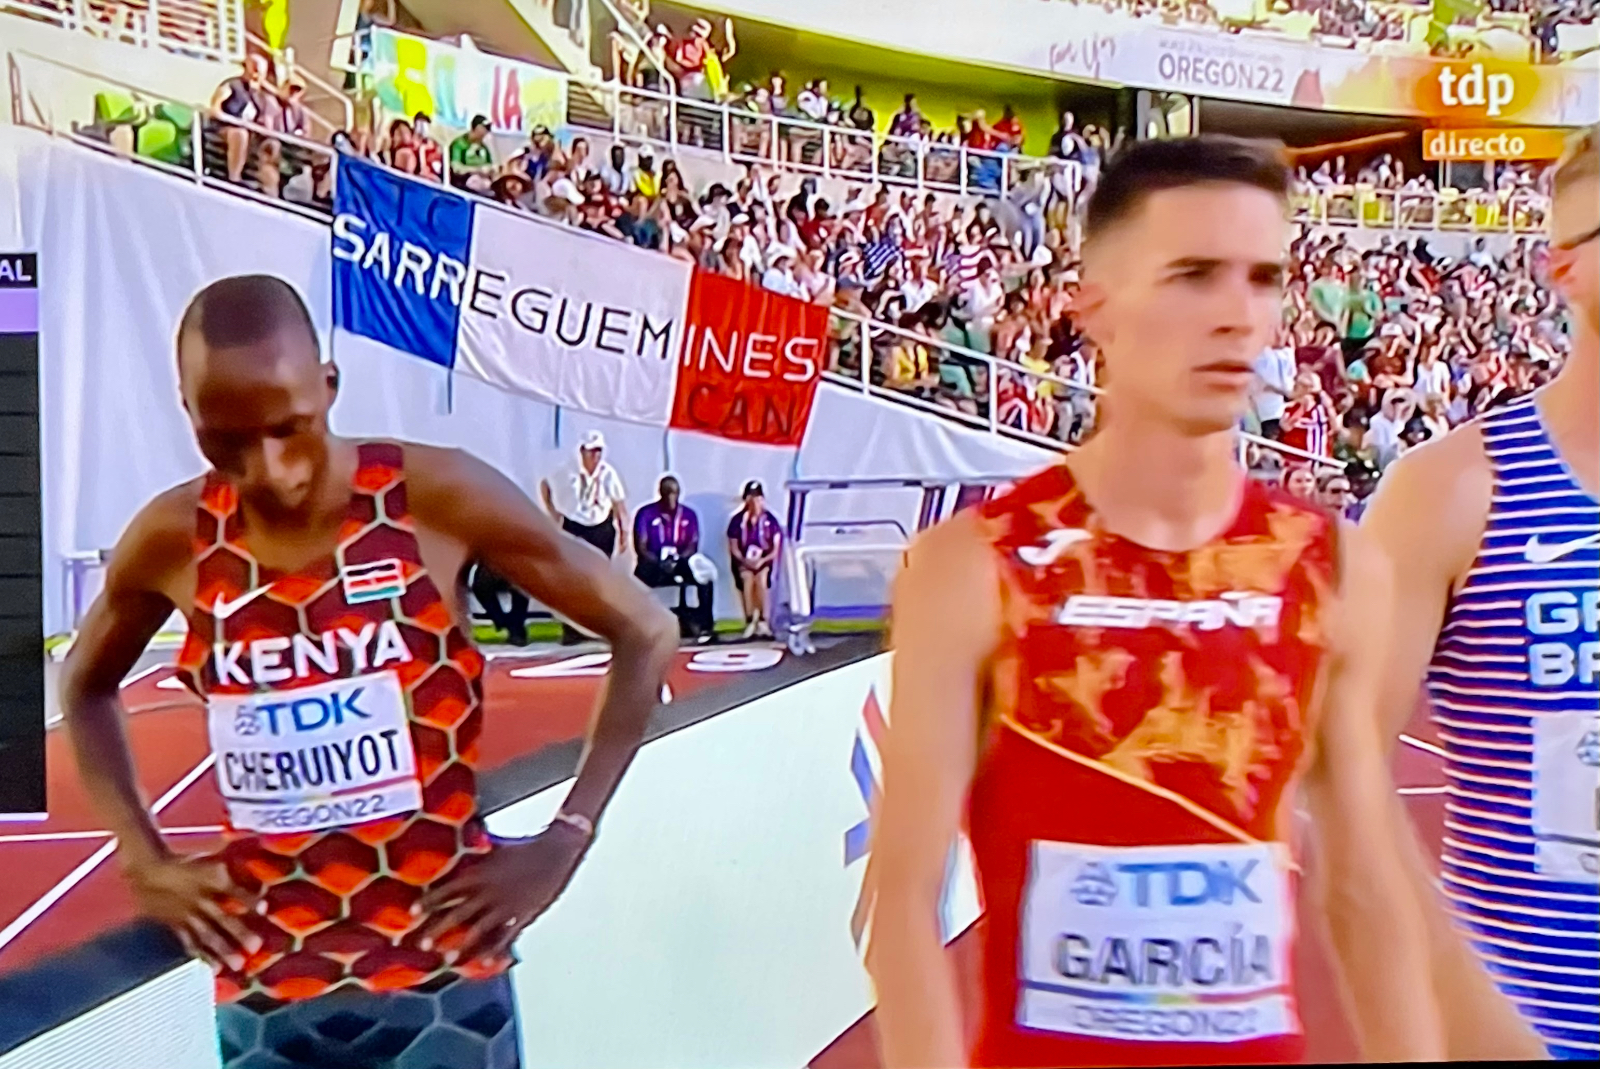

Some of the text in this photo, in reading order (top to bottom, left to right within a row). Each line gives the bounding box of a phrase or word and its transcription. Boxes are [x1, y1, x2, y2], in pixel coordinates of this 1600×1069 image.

[1158, 52, 1285, 93] OREGON22
[1438, 63, 1515, 117] tdp
[1430, 131, 1526, 157] directo
[332, 212, 819, 383] SARREGUEMINES
[687, 382, 798, 436] CAN
[213, 619, 413, 686] KENYA
[256, 686, 372, 736] TDK
[225, 729, 400, 792] CHERUIYOT
[1115, 858, 1263, 907] TDK
[1055, 921, 1272, 987] GARCÍA
